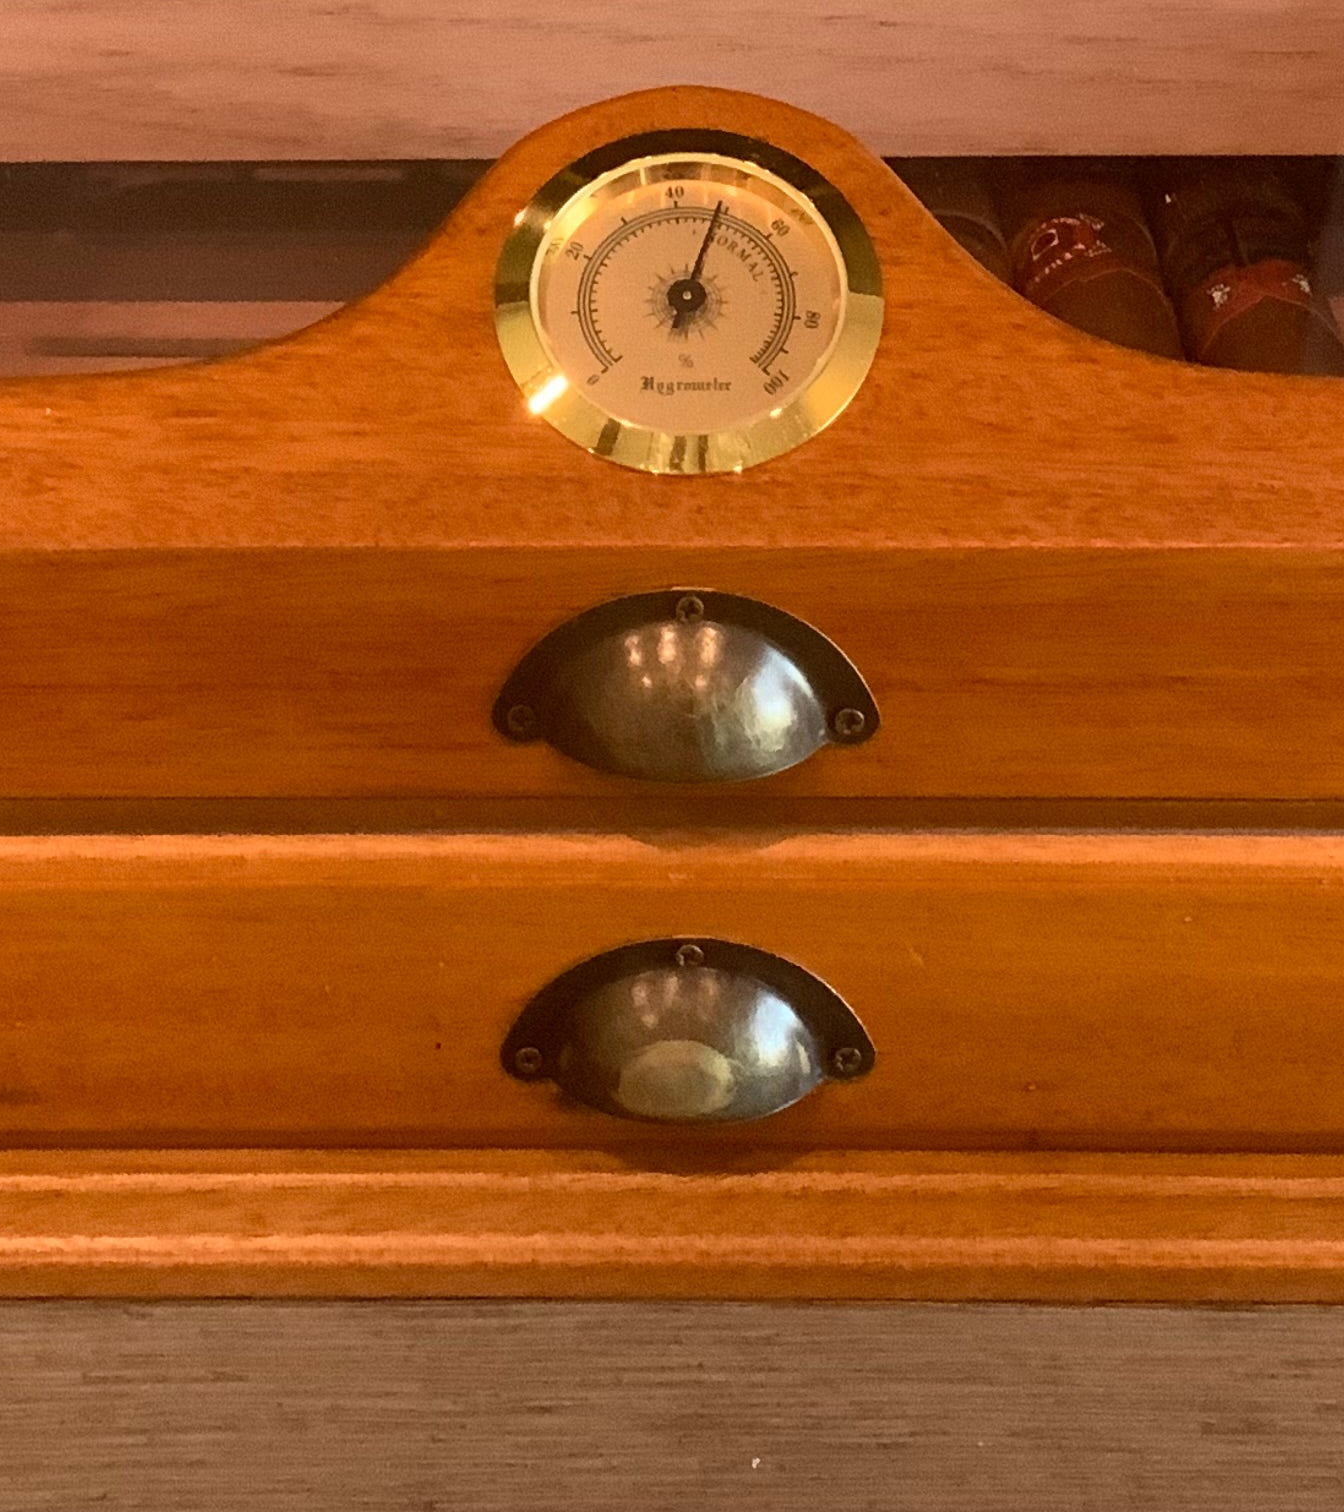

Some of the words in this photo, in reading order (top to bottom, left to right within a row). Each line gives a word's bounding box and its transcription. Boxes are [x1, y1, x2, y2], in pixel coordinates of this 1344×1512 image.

[665, 186, 684, 199] 40
[771, 219, 791, 237] 60
[566, 241, 584, 261] 20
[804, 310, 821, 329] 80
[587, 374, 600, 386] 0
[640, 376, 732, 395] Hygrometer
[763, 370, 789, 395] 100
